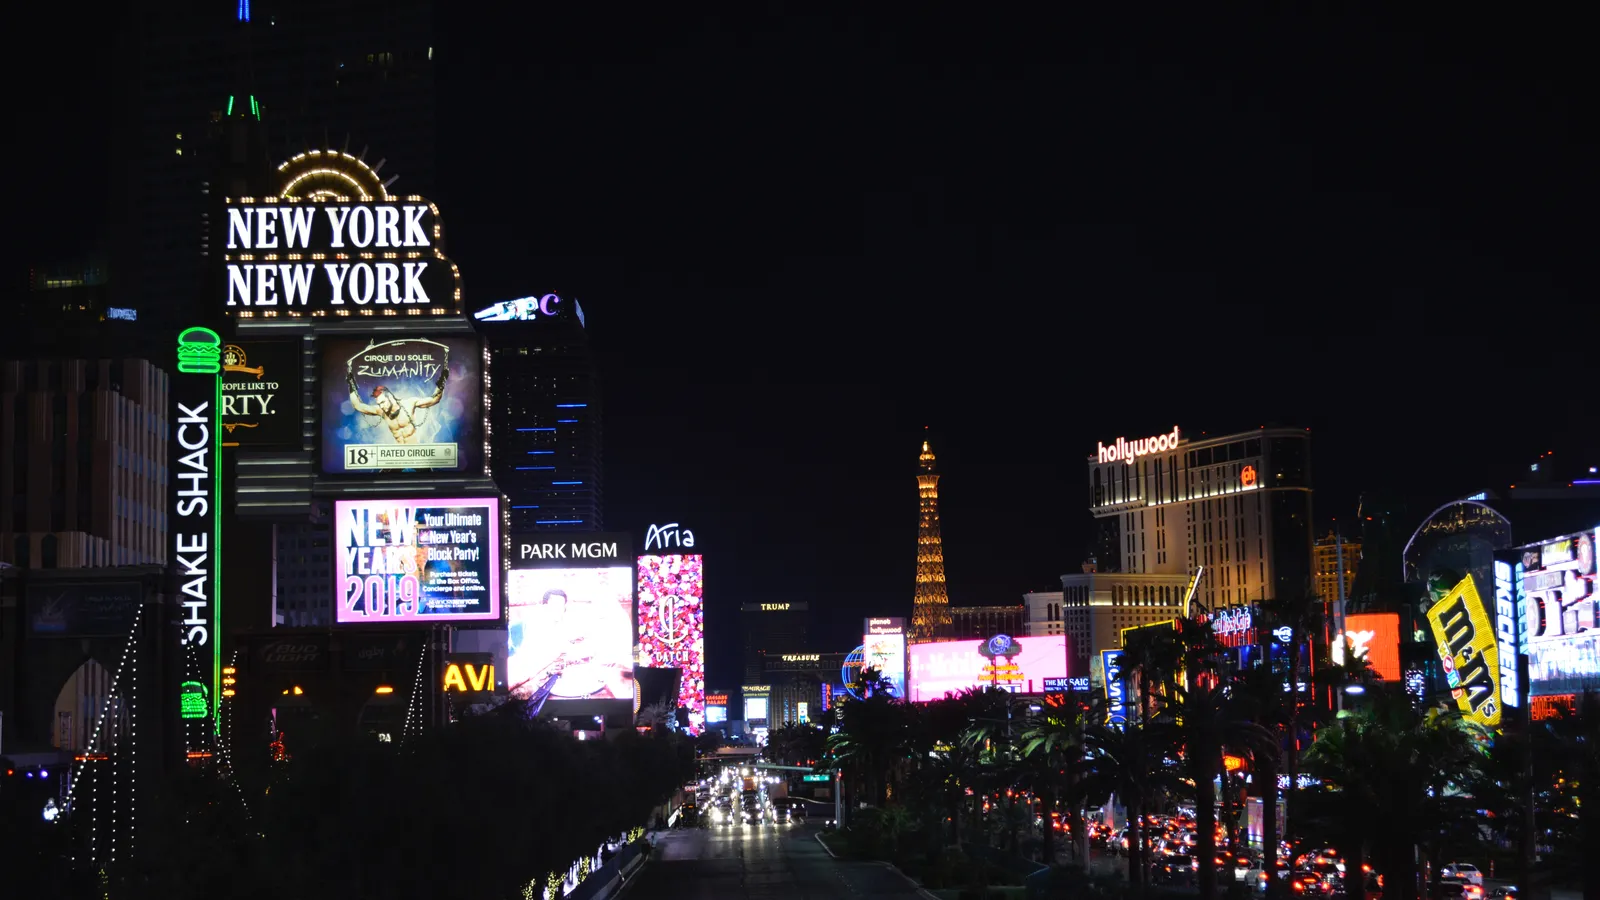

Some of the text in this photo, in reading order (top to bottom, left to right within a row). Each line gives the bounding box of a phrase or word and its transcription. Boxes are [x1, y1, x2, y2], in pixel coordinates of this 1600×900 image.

[227, 205, 430, 248] NEW YORK
[227, 262, 430, 306] NEW YORK
[364, 354, 392, 363] CIRQUE
[357, 362, 440, 382] ZUMANITY
[222, 382, 279, 390] EOPLE LIKE TO
[222, 394, 276, 416] RTY.
[1098, 426, 1179, 464] hollywood
[176, 401, 209, 646] SHAKE SHACK
[349, 508, 416, 546] NEW
[424, 514, 481, 526] Your Ultimate
[429, 530, 476, 543] New Year's
[644, 523, 694, 550] Aria
[428, 547, 479, 561] Block Party!
[521, 542, 617, 559] PARK MGM
[345, 575, 419, 616] 2019
[1495, 560, 1519, 708] SKECHERS
[656, 651, 688, 662] CATCH
